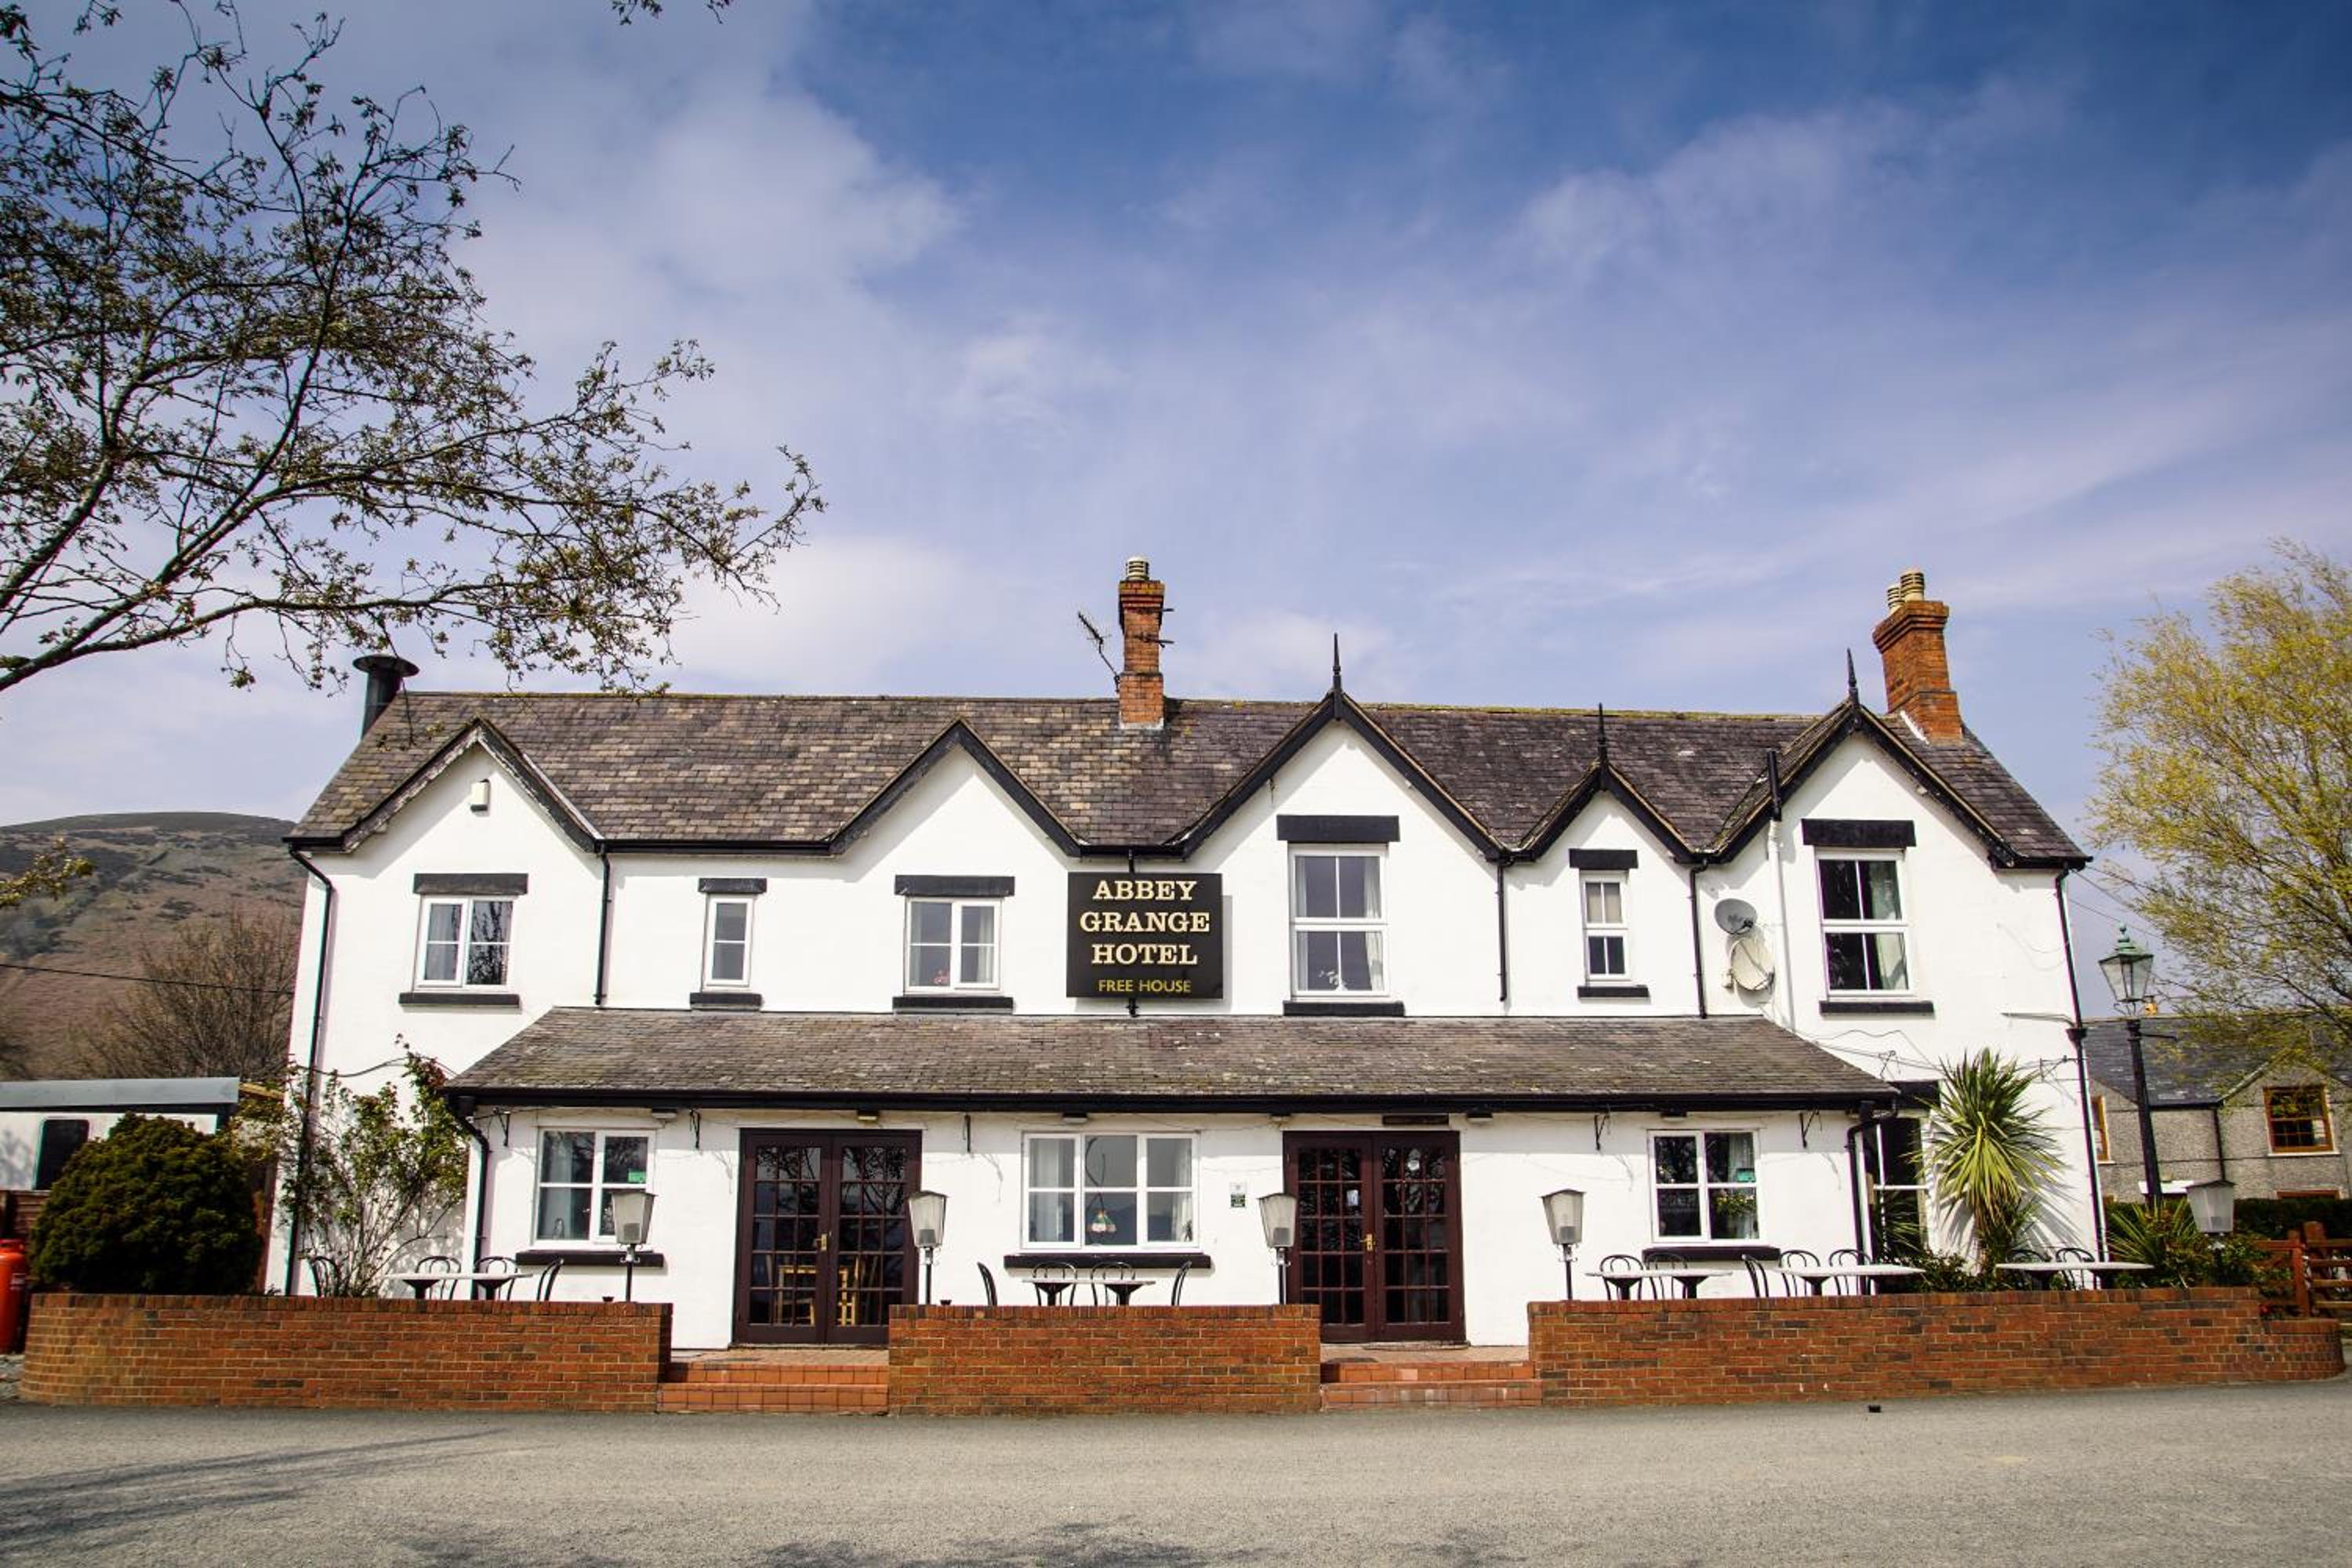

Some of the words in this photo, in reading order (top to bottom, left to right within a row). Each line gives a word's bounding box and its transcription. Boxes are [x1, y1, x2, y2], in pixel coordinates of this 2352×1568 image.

[1092, 880, 1197, 900] ABBEY
[1080, 911, 1210, 932] GRANGE
[1091, 944, 1198, 964] HOTEL
[1099, 980, 1133, 992] FREE
[1139, 980, 1191, 993] HOUSE
